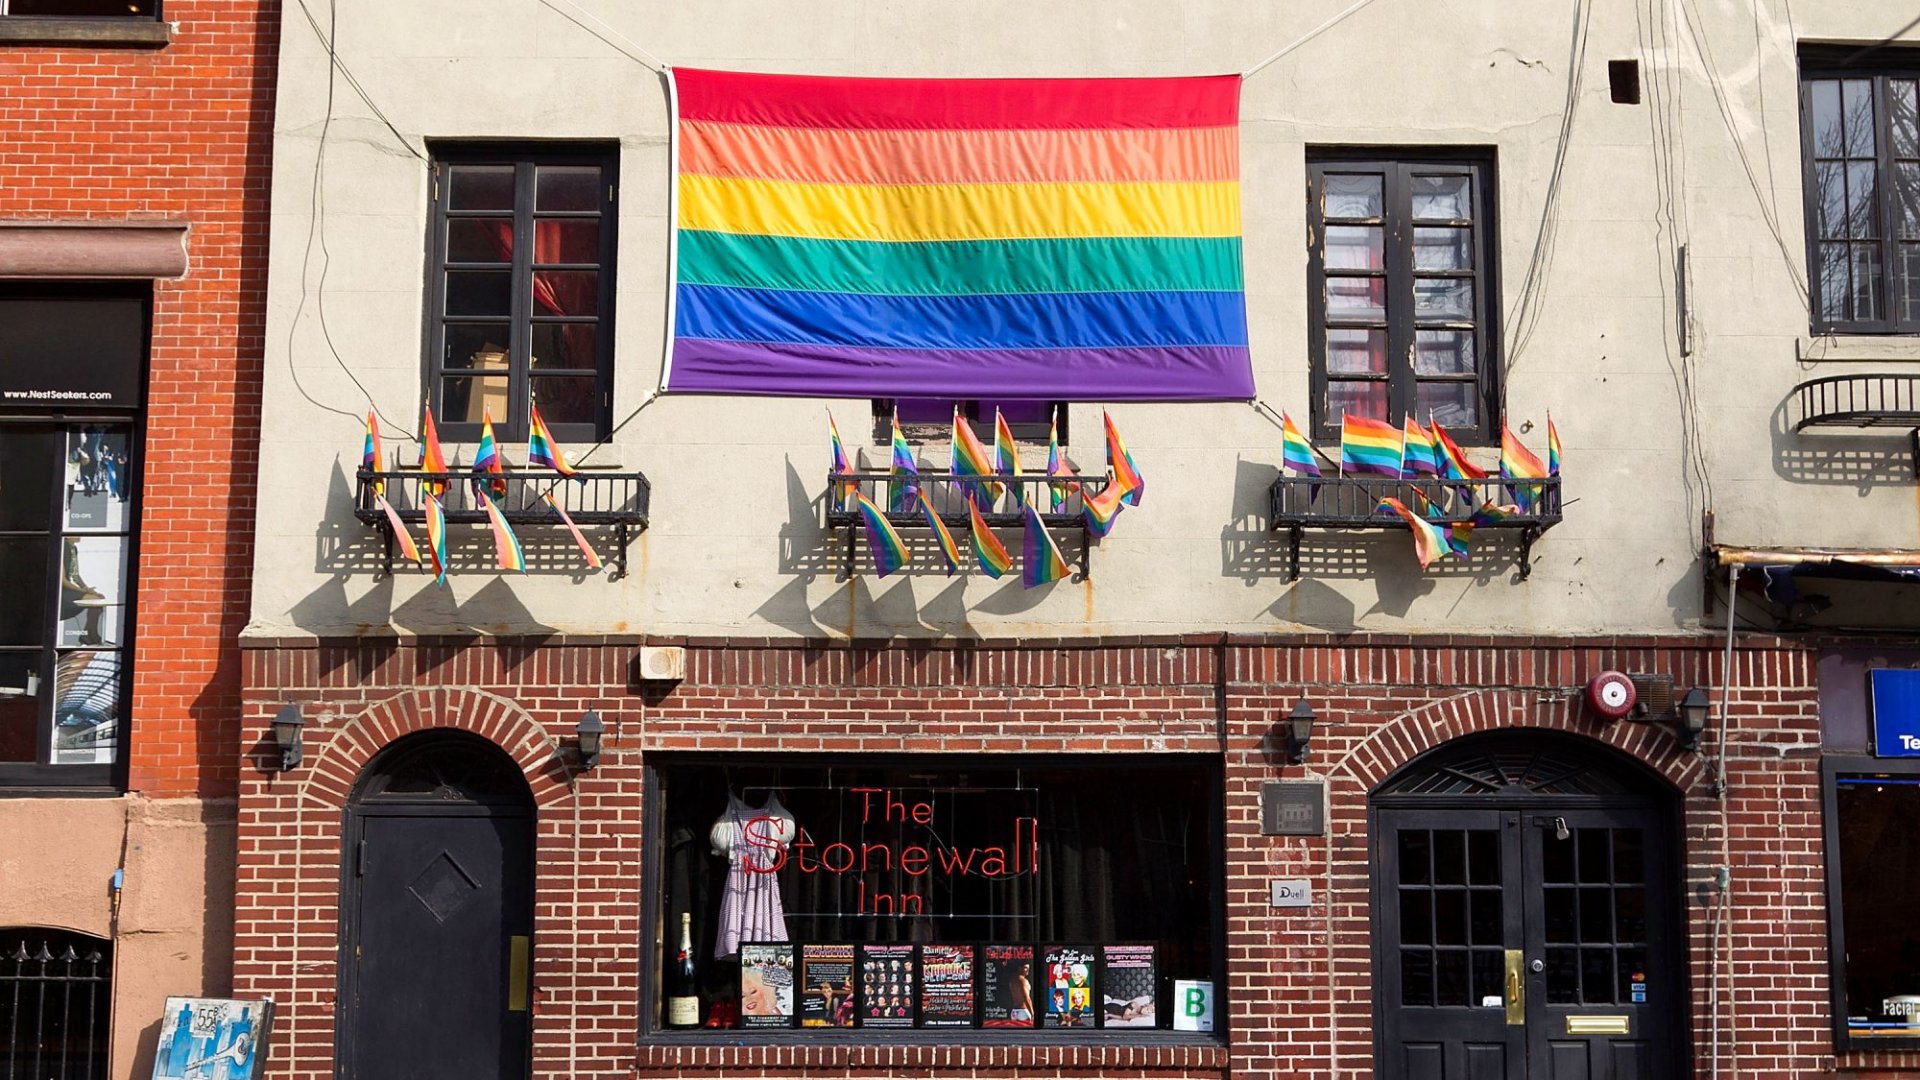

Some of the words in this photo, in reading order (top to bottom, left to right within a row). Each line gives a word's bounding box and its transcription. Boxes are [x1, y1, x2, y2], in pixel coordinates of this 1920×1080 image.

[4, 390, 112, 399] www.NestSeekers.com
[851, 789, 932, 824] The
[744, 816, 1038, 876] Stonewall
[859, 880, 923, 916] Inn
[1279, 886, 1304, 898] Duell
[1186, 988, 1205, 1017] B
[1883, 999, 1915, 1016] Facial
[197, 1008, 213, 1029] 55
